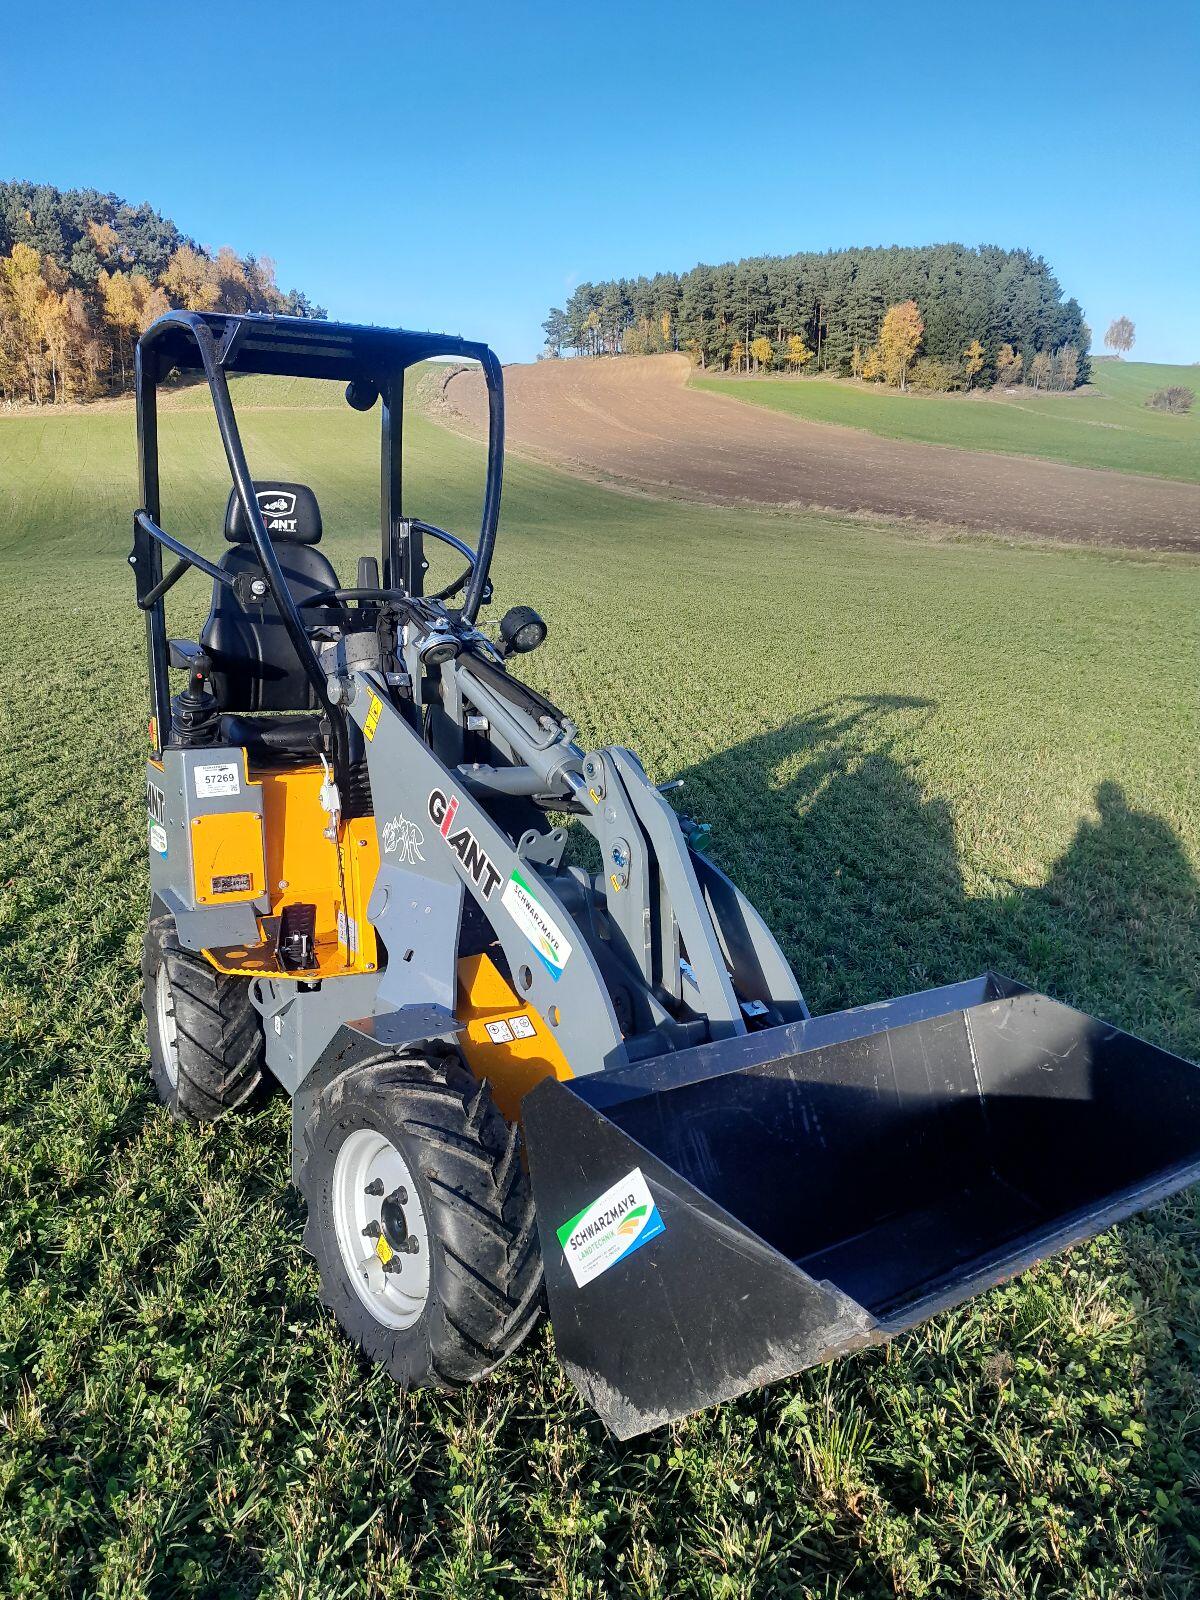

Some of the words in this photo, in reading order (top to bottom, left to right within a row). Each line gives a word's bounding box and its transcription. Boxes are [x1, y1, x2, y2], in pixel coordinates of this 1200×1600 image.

[263, 516, 297, 530] iANT
[205, 773, 234, 784] 57269
[147, 781, 165, 826] ANT
[514, 885, 559, 950] SCHWARZMAYR
[570, 1194, 637, 1251] SCHWARZMAYR
[578, 1229, 617, 1261] LANDTECHNIK
